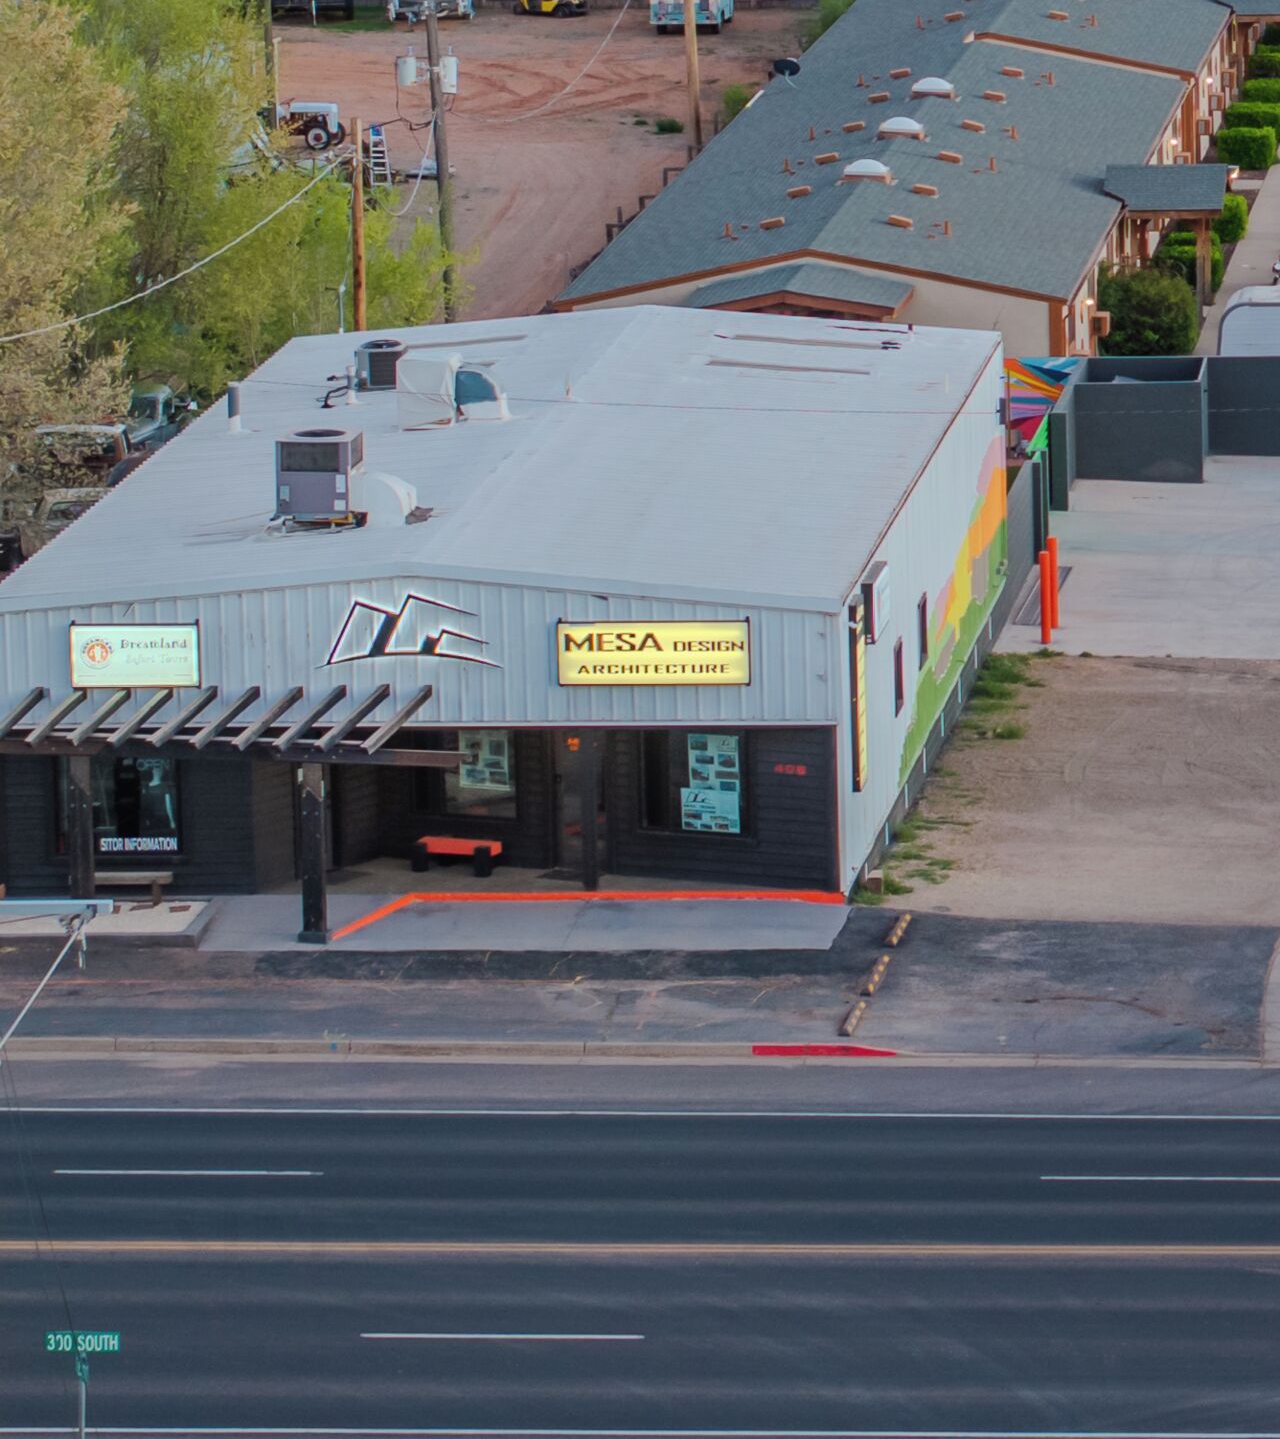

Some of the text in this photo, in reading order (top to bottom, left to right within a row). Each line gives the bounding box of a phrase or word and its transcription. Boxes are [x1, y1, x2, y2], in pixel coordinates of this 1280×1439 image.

[564, 633, 745, 652] MESA DESIGN
[577, 664, 731, 675] ARCHITECTURE
[124, 837, 178, 851] INFORMATION
[77, 1334, 119, 1351] SOUTH
